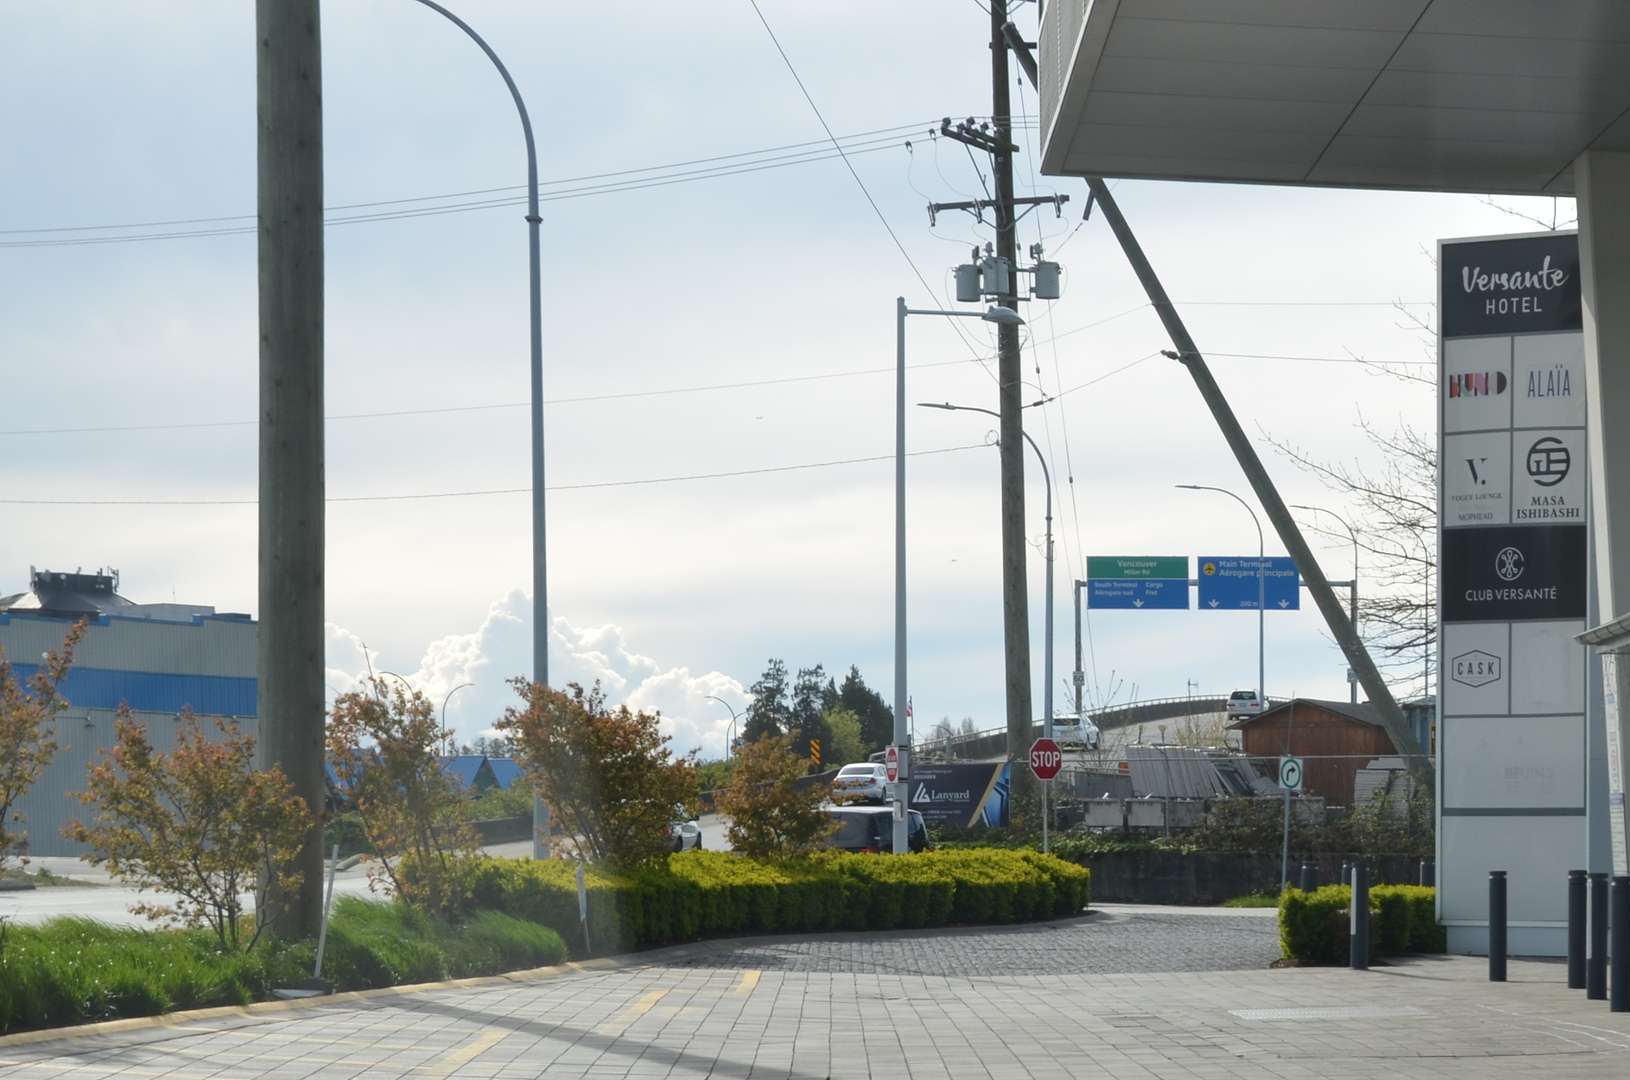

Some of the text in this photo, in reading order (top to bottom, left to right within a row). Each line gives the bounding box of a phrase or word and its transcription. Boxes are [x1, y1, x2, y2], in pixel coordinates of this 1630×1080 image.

[1462, 255, 1569, 293] Versante
[1486, 297, 1543, 315] HOTEL
[1527, 363, 1572, 399] ALAÏA
[1530, 496, 1565, 506] MASA
[1516, 508, 1580, 520] ISHIBASHI
[1218, 560, 1238, 568] Main
[1256, 569, 1294, 579] pincipale
[1465, 589, 1494, 602] CLUB
[1457, 661, 1495, 676] CASK
[1032, 750, 1061, 768] STOP
[931, 789, 970, 801] Lanyard
